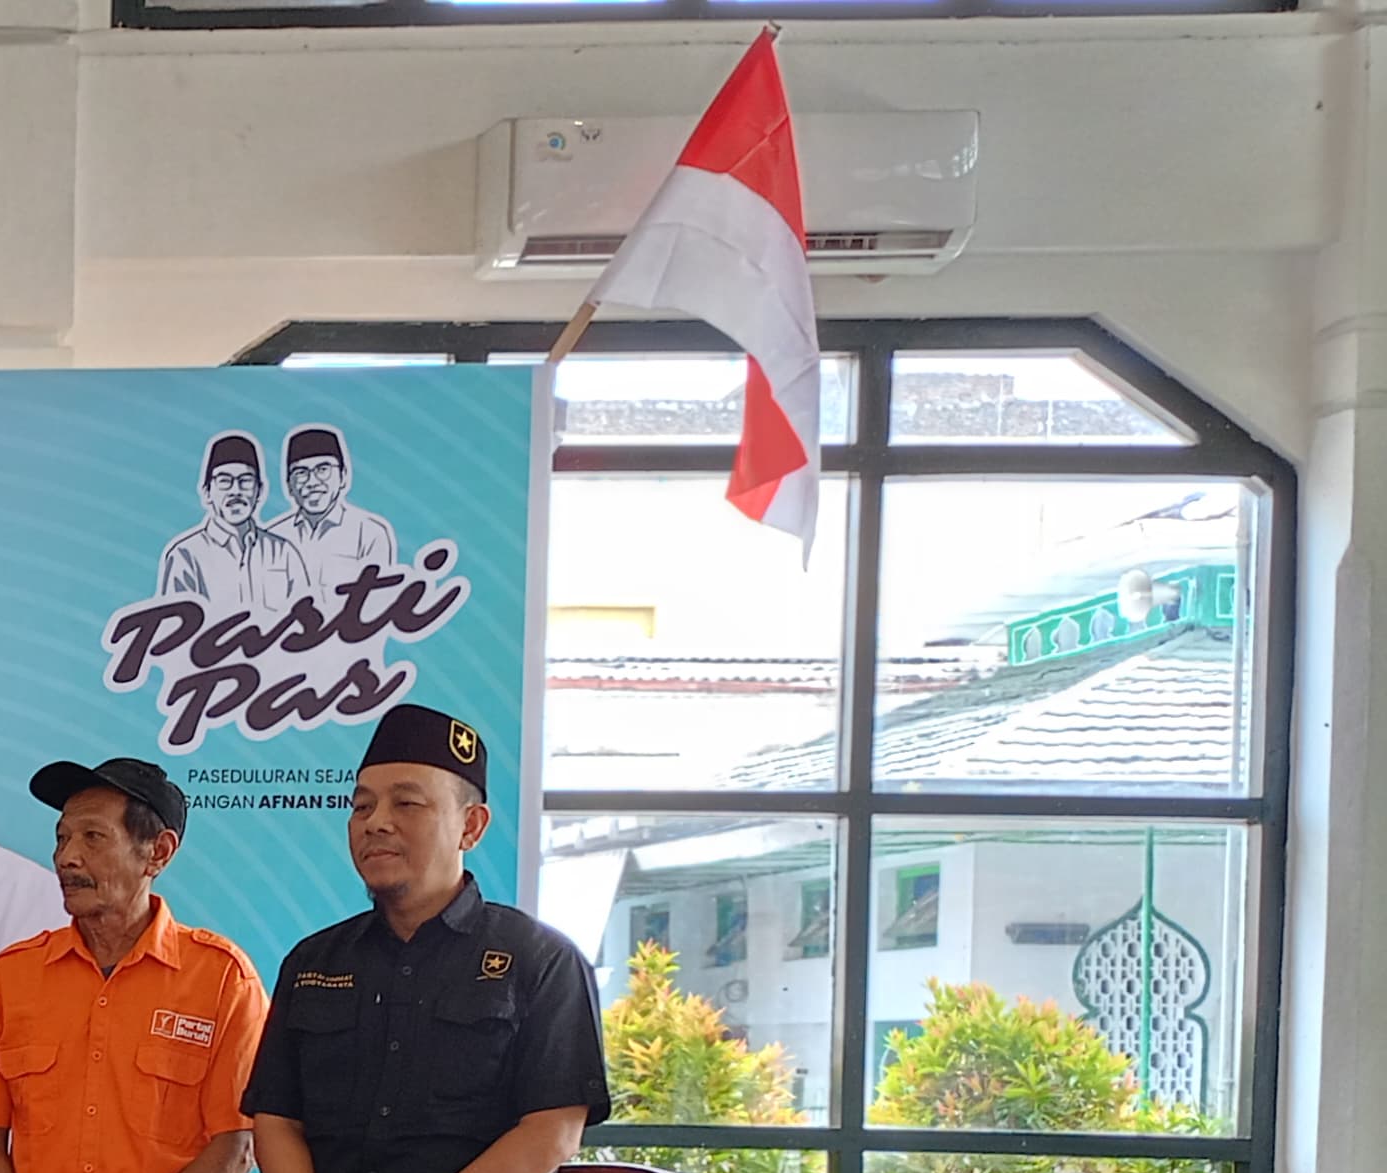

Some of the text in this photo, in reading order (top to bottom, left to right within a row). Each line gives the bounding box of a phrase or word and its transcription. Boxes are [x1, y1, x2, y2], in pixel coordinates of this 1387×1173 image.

[110, 548, 462, 684] Pasti
[165, 658, 407, 746] Pas
[188, 769, 355, 783] PASEDULURAN SEJA
[184, 795, 255, 809] SANGAN
[258, 795, 322, 809] AFNAN
